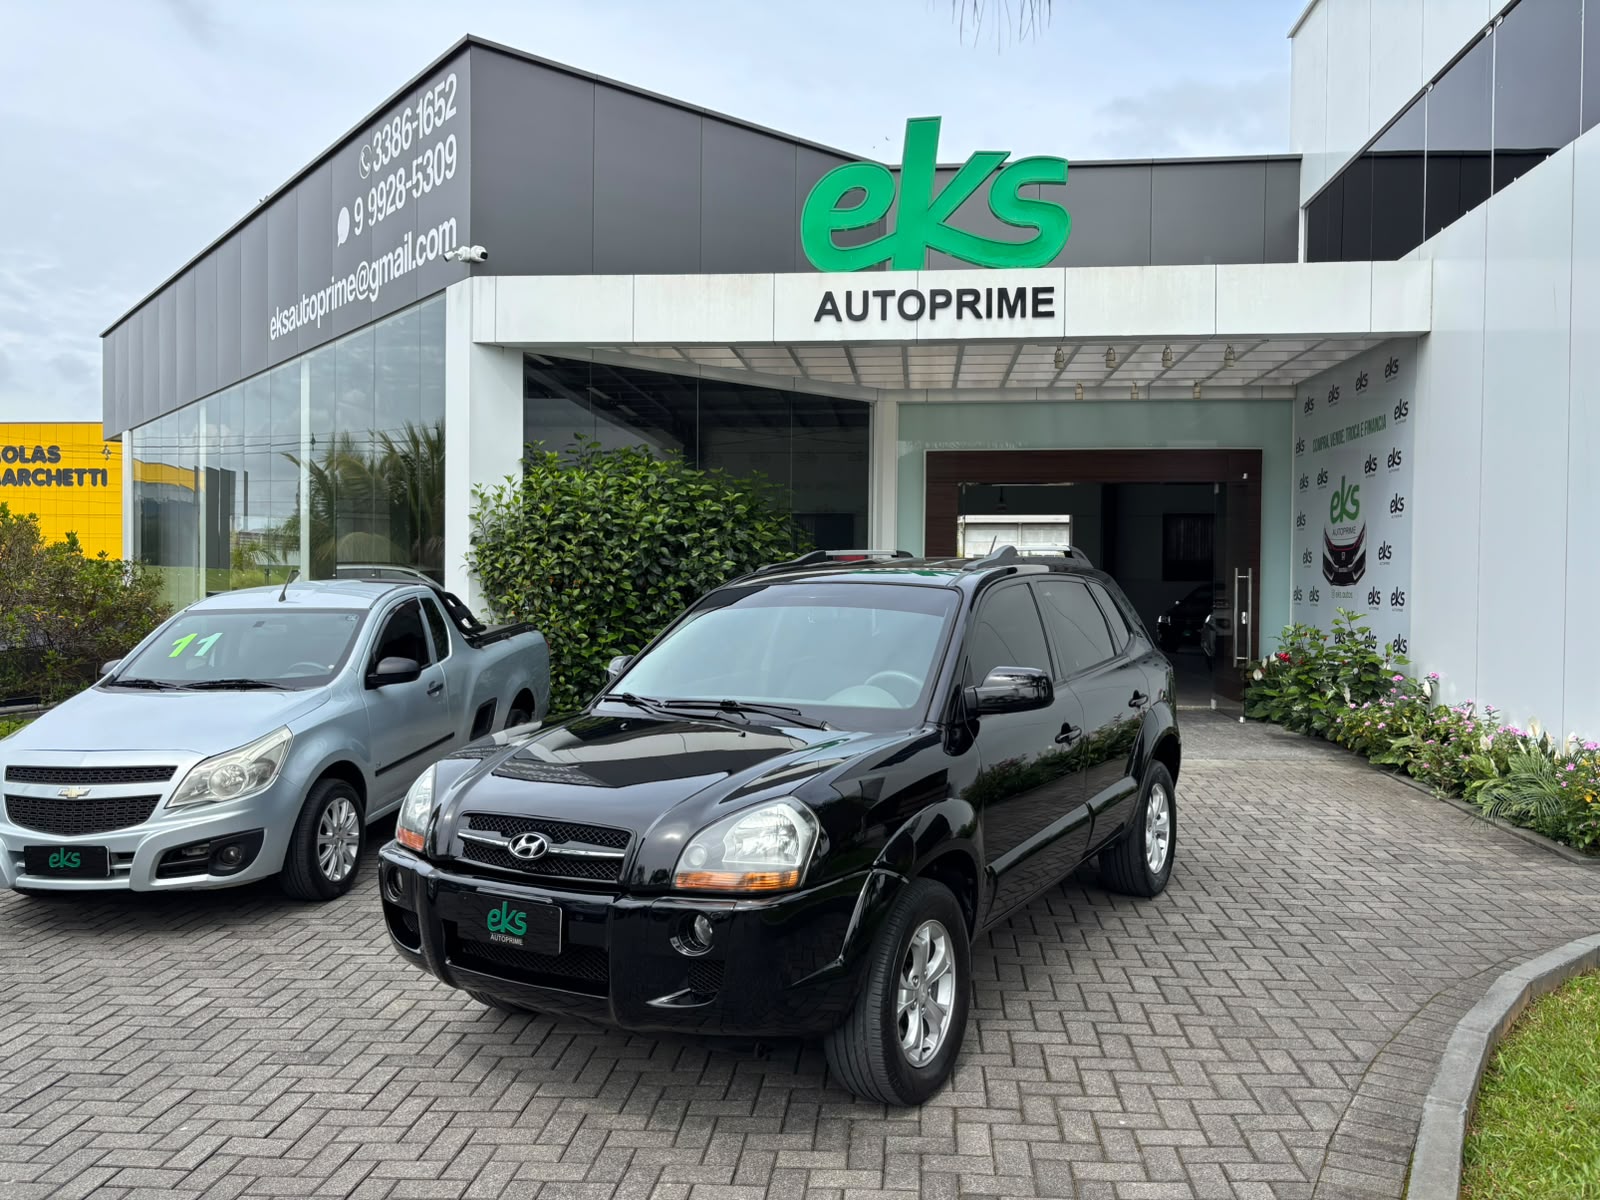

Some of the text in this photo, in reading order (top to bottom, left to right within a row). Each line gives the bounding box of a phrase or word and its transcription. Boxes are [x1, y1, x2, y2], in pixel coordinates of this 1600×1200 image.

[372, 73, 457, 172] 3386-1652
[353, 134, 457, 236] 9 9928-5309
[801, 116, 1072, 272] eks
[270, 217, 457, 340] eksautoprime@gmail.com
[814, 286, 1055, 322] AUTOPRIME
[1384, 357, 1399, 378] eks
[1355, 371, 1368, 391] eks
[1328, 384, 1339, 403] eks
[1304, 396, 1314, 414] eks
[1394, 399, 1408, 420] eks
[0, 445, 61, 464] OLAS
[1365, 454, 1377, 474] eks
[1387, 447, 1401, 468] eks
[0, 468, 108, 487] ARCHETTI
[1317, 468, 1328, 486] eks
[1330, 475, 1360, 524] eks
[1390, 493, 1404, 514] eks
[1378, 540, 1392, 561] eks
[1368, 586, 1381, 606] eks
[1391, 586, 1405, 607] eks
[168, 633, 223, 658] 11
[1393, 633, 1407, 654] eks
[48, 847, 81, 869] eks
[487, 901, 528, 936] eks
[490, 933, 524, 946] AUTOPRIME
